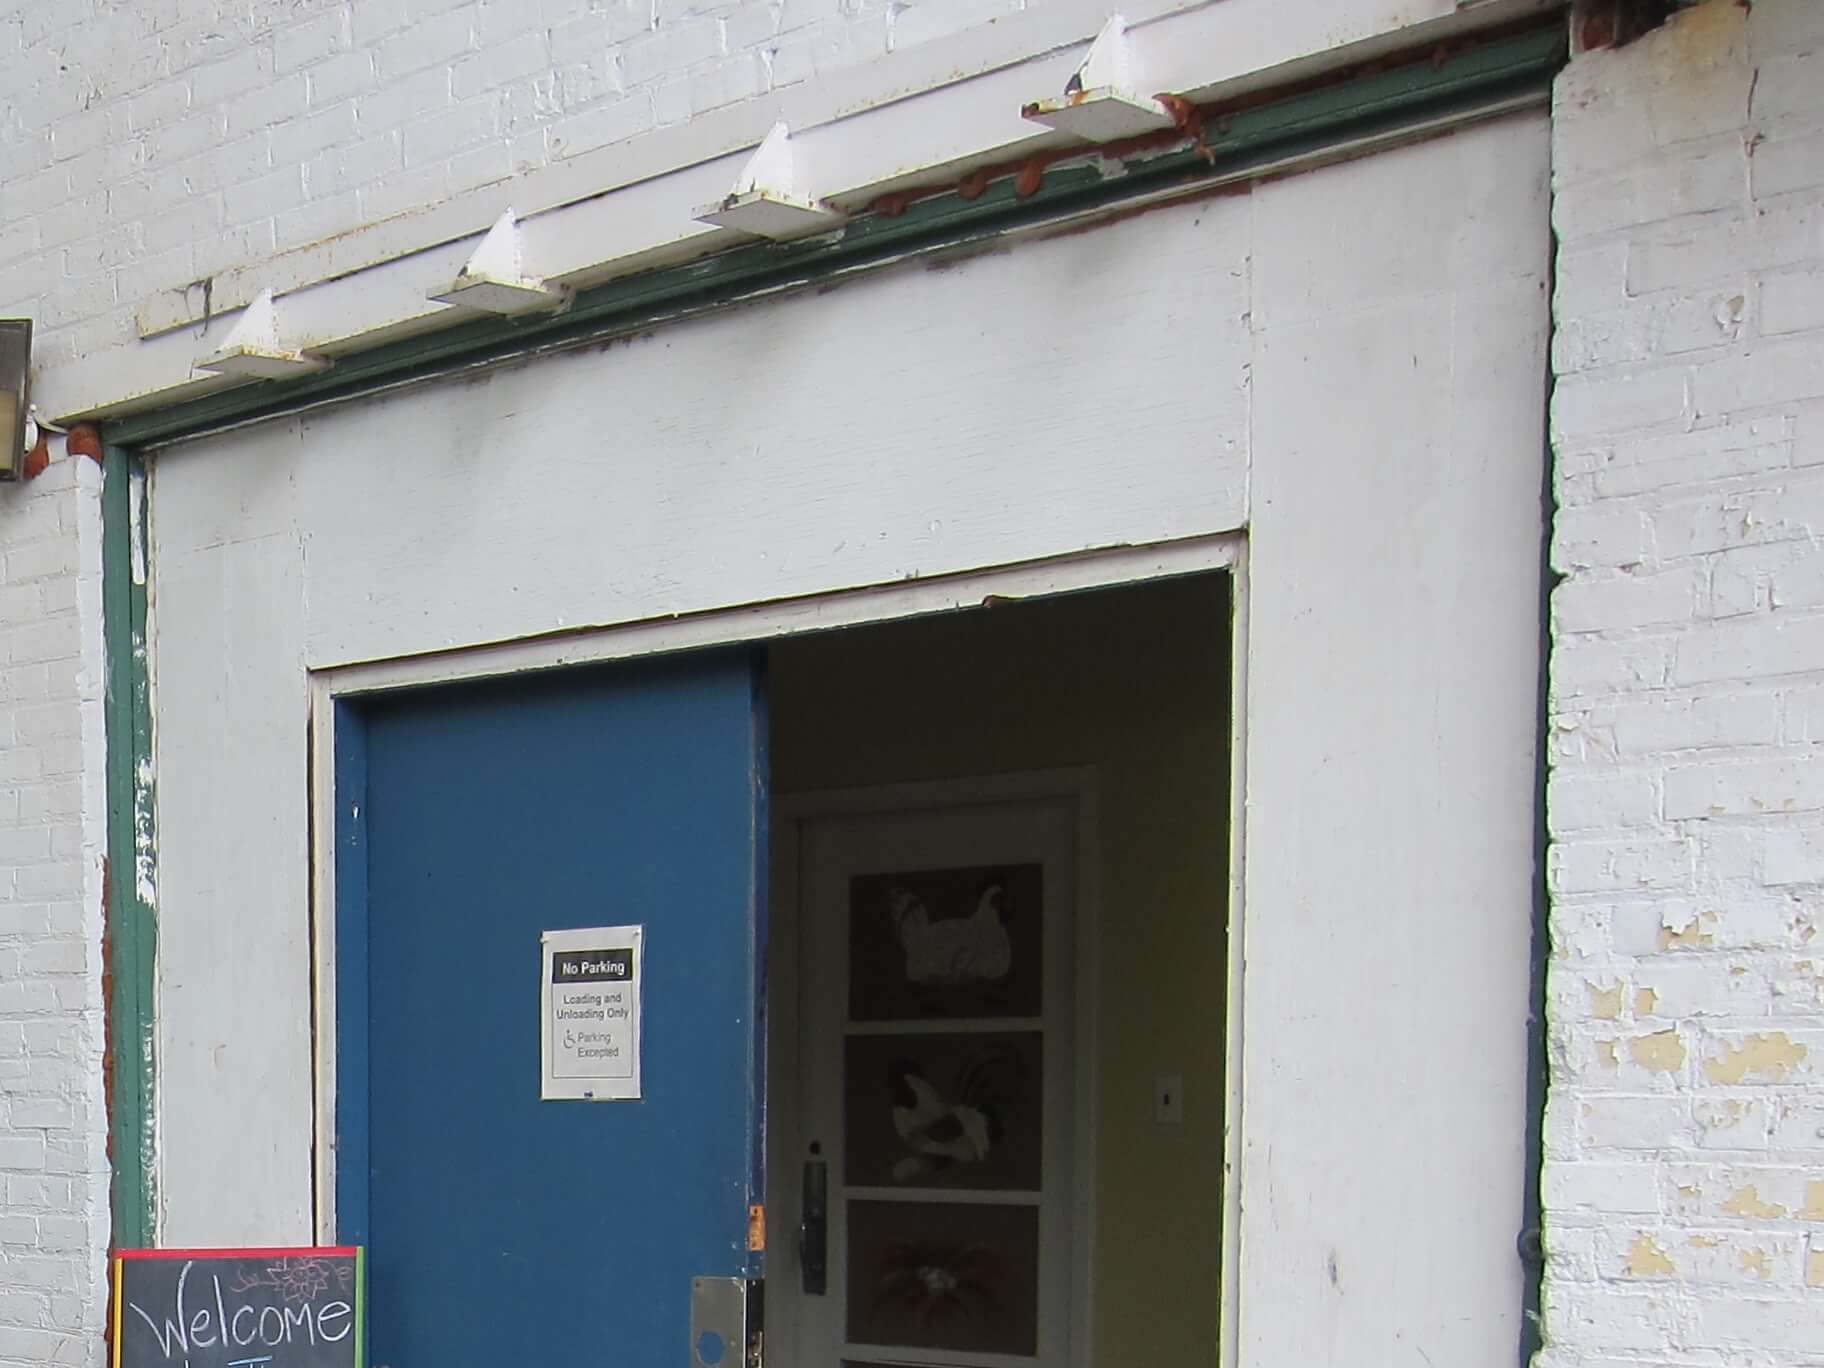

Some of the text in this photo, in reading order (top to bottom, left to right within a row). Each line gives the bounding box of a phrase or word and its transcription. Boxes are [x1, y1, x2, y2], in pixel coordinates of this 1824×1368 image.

[562, 960, 625, 976] No Parking
[563, 992, 622, 1006] Loading and
[556, 1008, 630, 1021] Unloading Only
[577, 1031, 612, 1045] Parking
